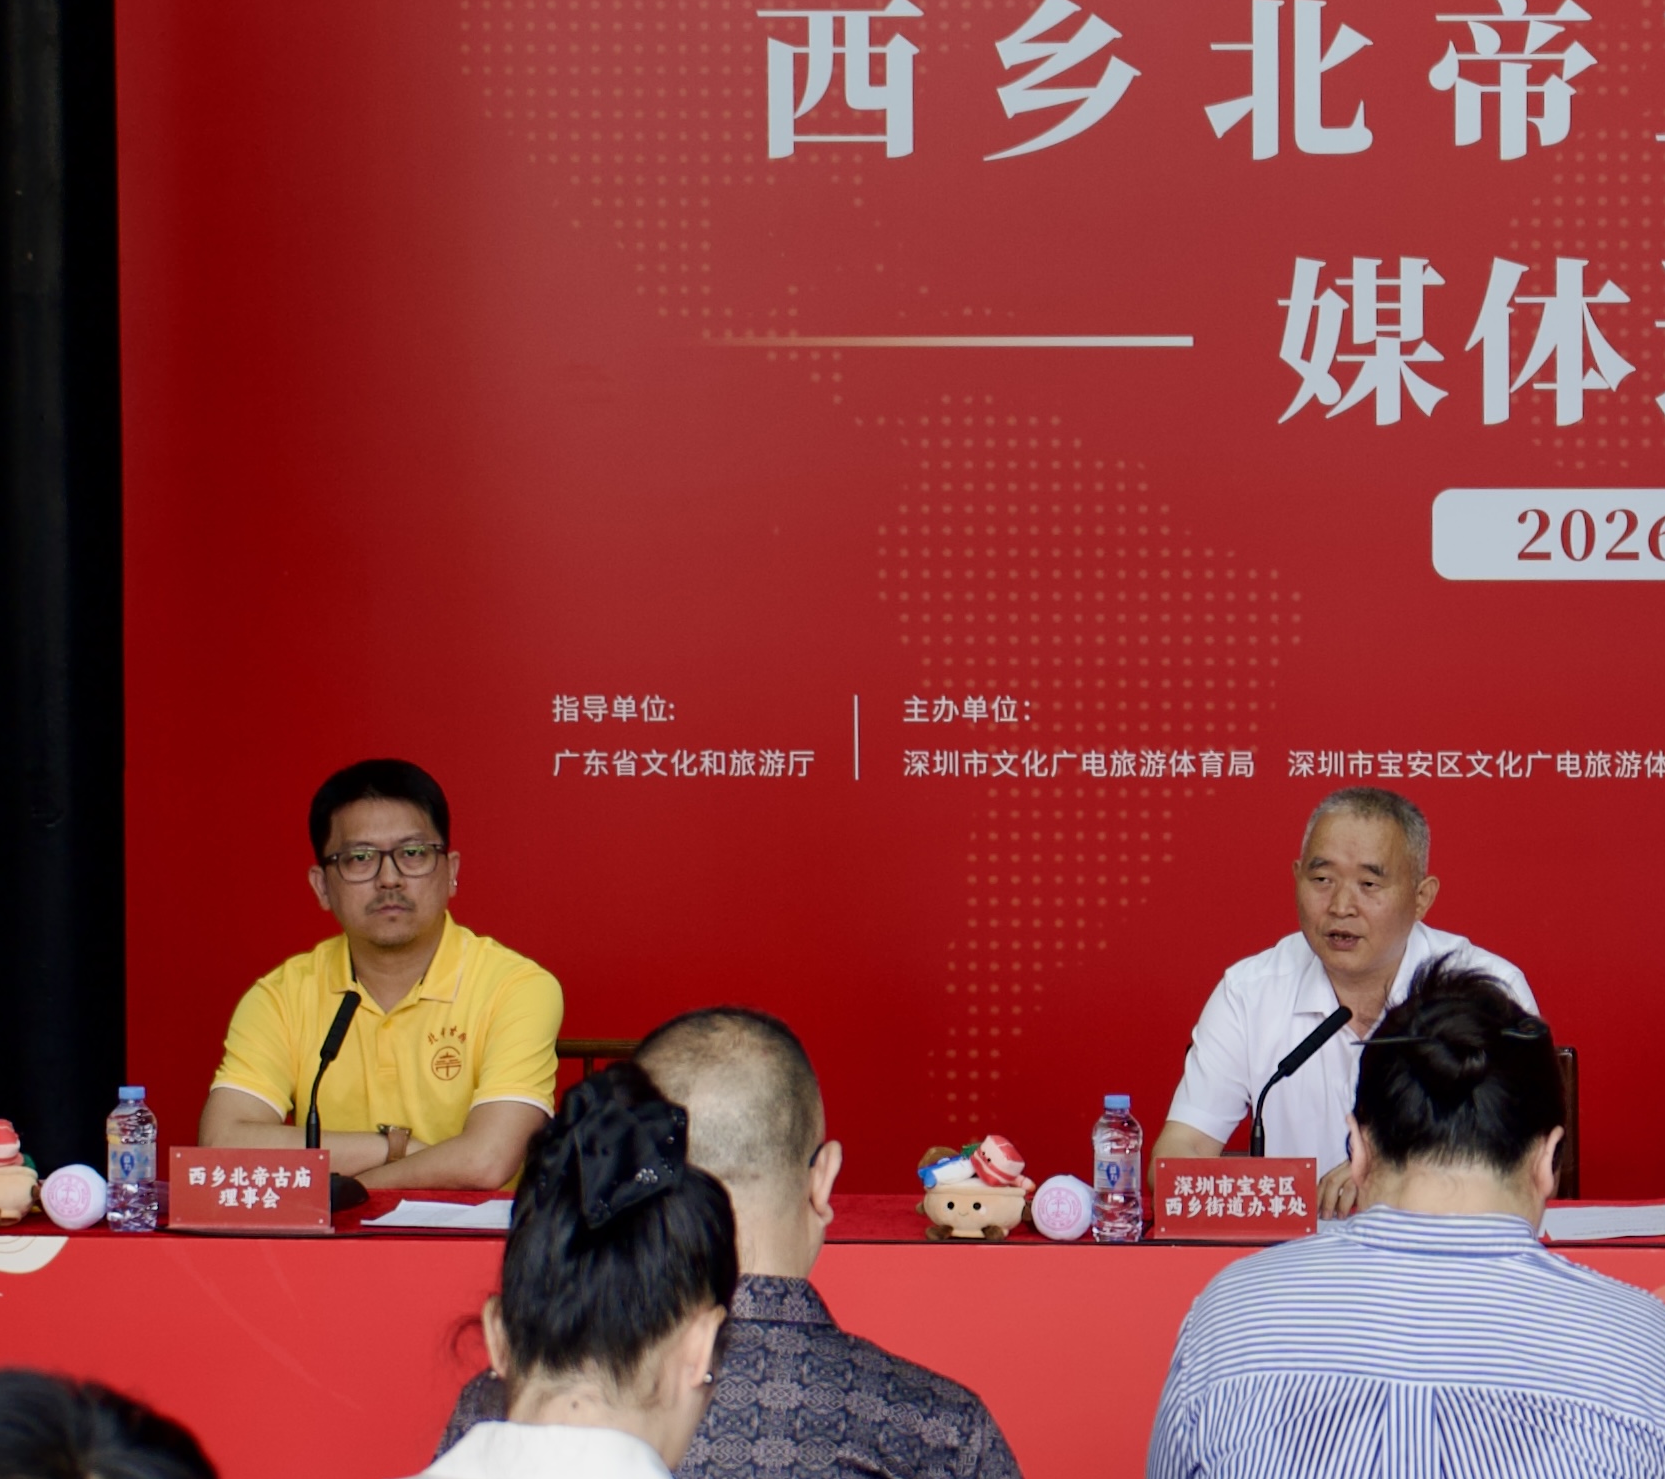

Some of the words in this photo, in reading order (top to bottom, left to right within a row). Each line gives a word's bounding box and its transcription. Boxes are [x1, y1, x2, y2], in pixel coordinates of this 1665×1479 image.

[552, 749, 816, 778] 广东省文化和旅游厅
[903, 749, 1255, 779] 深圳市文化广电旅游体育局
[188, 1165, 312, 1189] 西乡北帝古庙
[1173, 1174, 1297, 1197] 深圳市宝安区
[218, 1187, 281, 1210] 理事会
[1164, 1195, 1309, 1219] 西乡街道办事处
